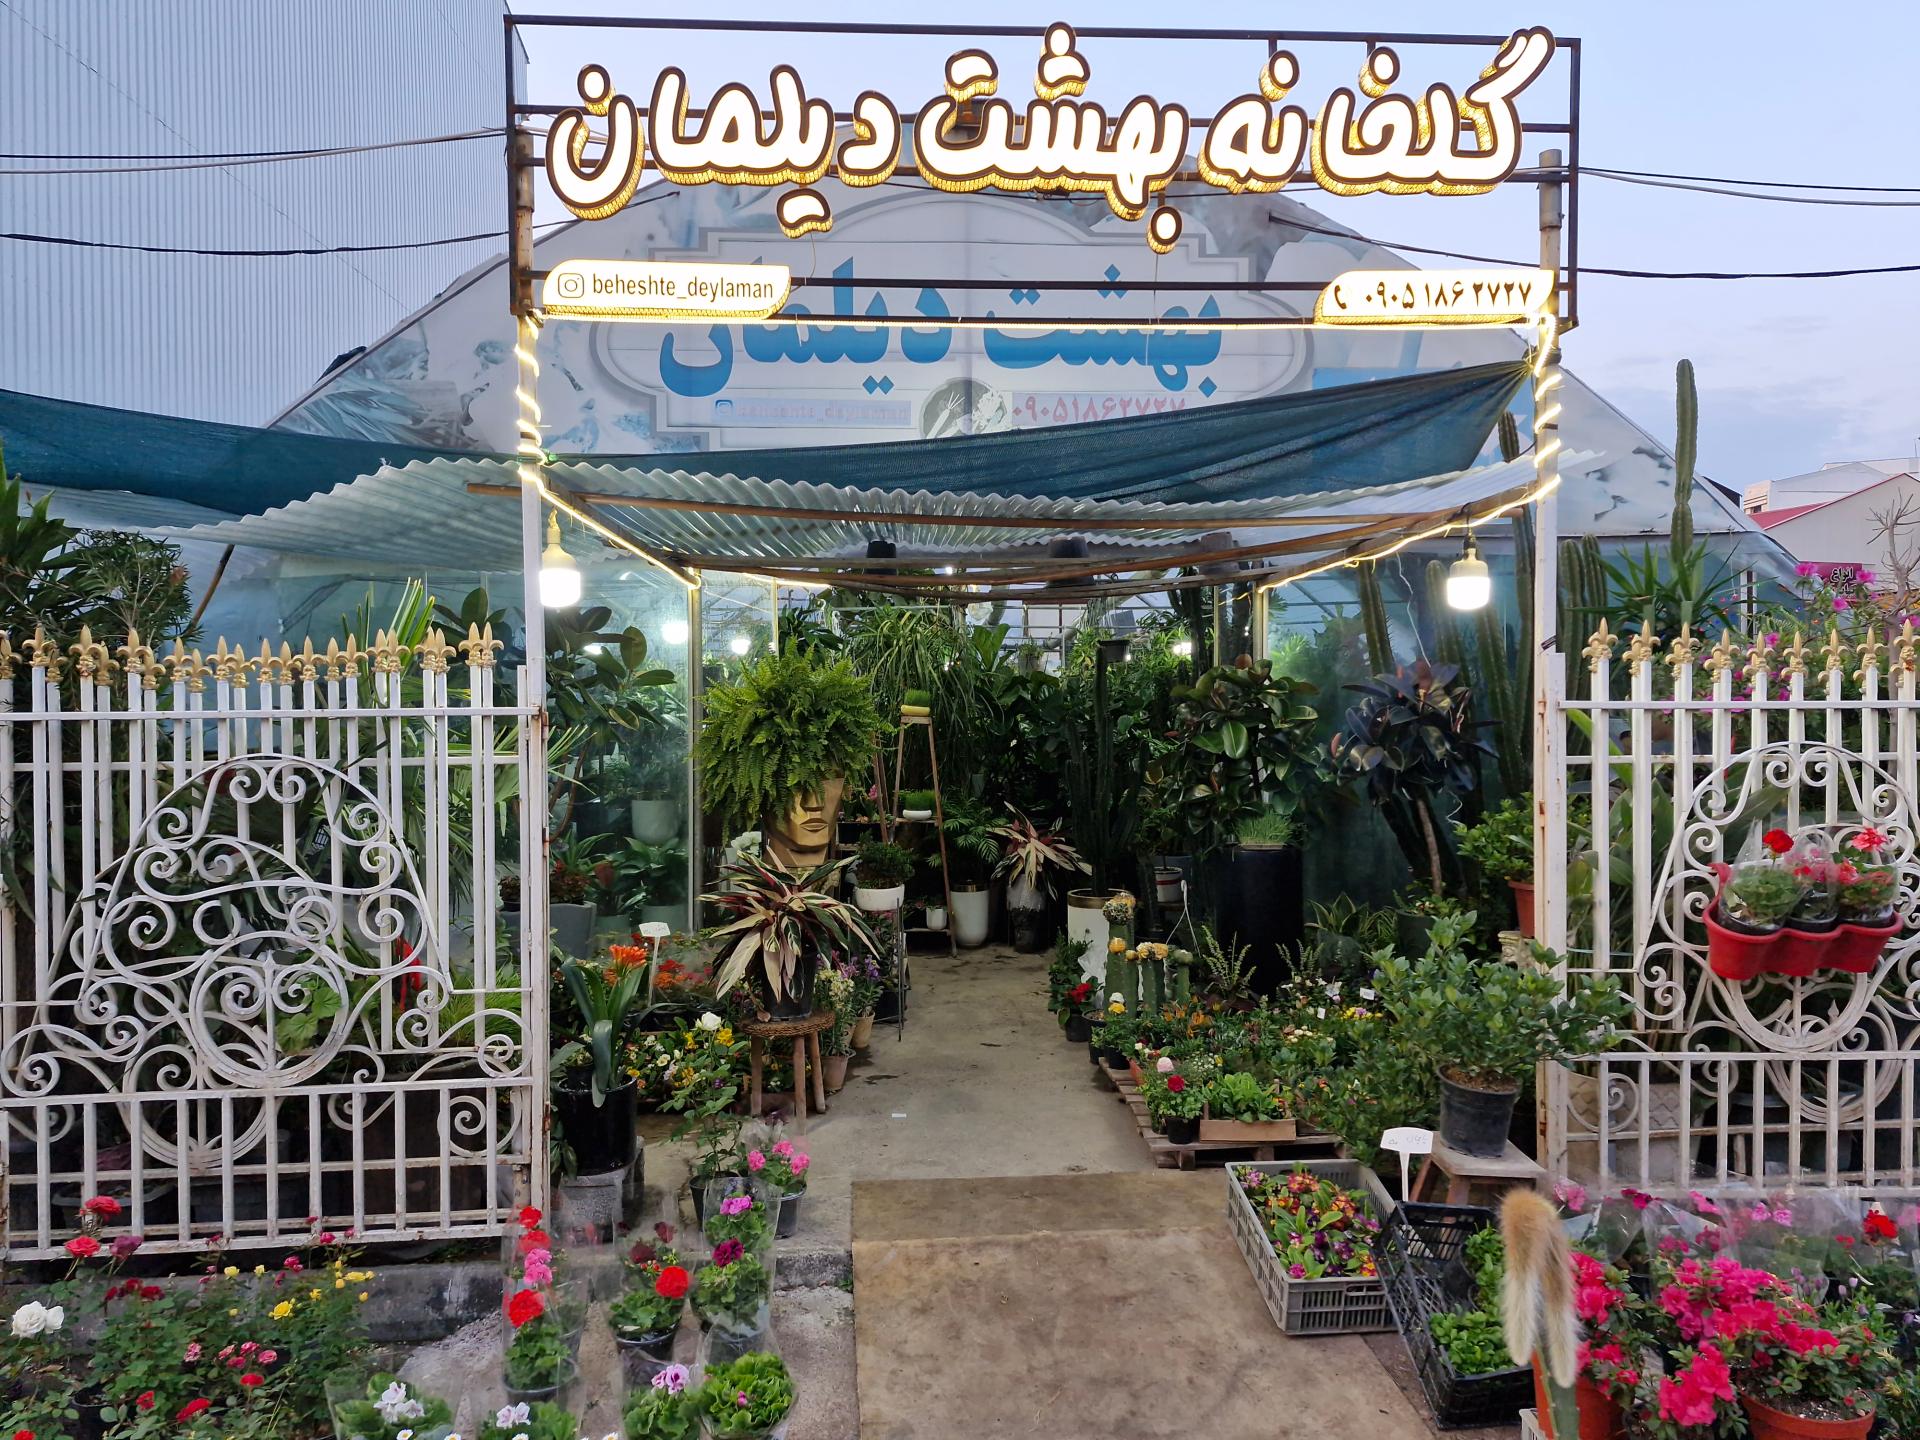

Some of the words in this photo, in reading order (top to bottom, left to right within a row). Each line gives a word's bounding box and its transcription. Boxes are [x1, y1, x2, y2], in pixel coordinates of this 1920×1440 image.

[546, 63, 902, 238] دیلمان
[913, 21, 1190, 254] بهشت
[1198, 26, 1556, 196] گلخانه
[592, 273, 774, 303] beheshte_deylaman
[983, 263, 1222, 398] بهشت
